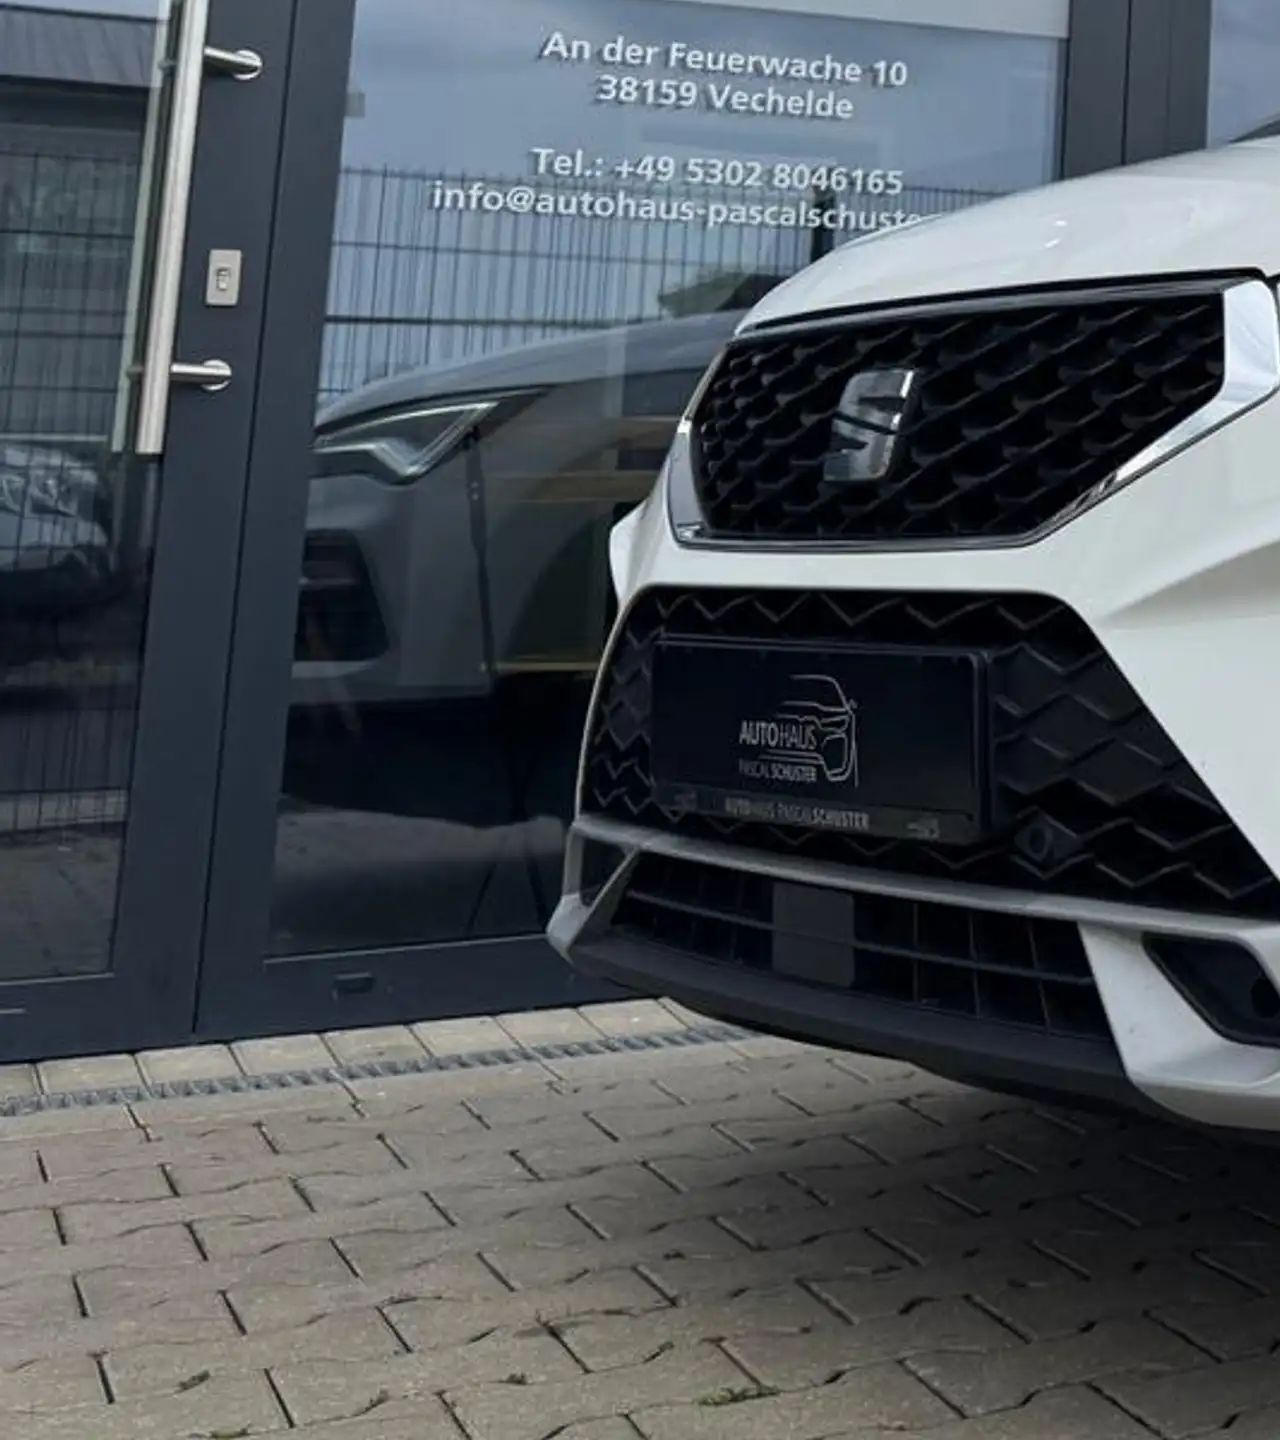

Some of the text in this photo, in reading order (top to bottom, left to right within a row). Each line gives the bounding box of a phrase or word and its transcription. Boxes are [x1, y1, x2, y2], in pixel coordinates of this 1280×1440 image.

[542, 31, 909, 87] An der Feuerwache 10
[597, 73, 855, 119] 38159 Vechelde
[532, 147, 904, 196] Tel.: +49 5302 8046165
[770, 762, 818, 784] SCHUSTER
